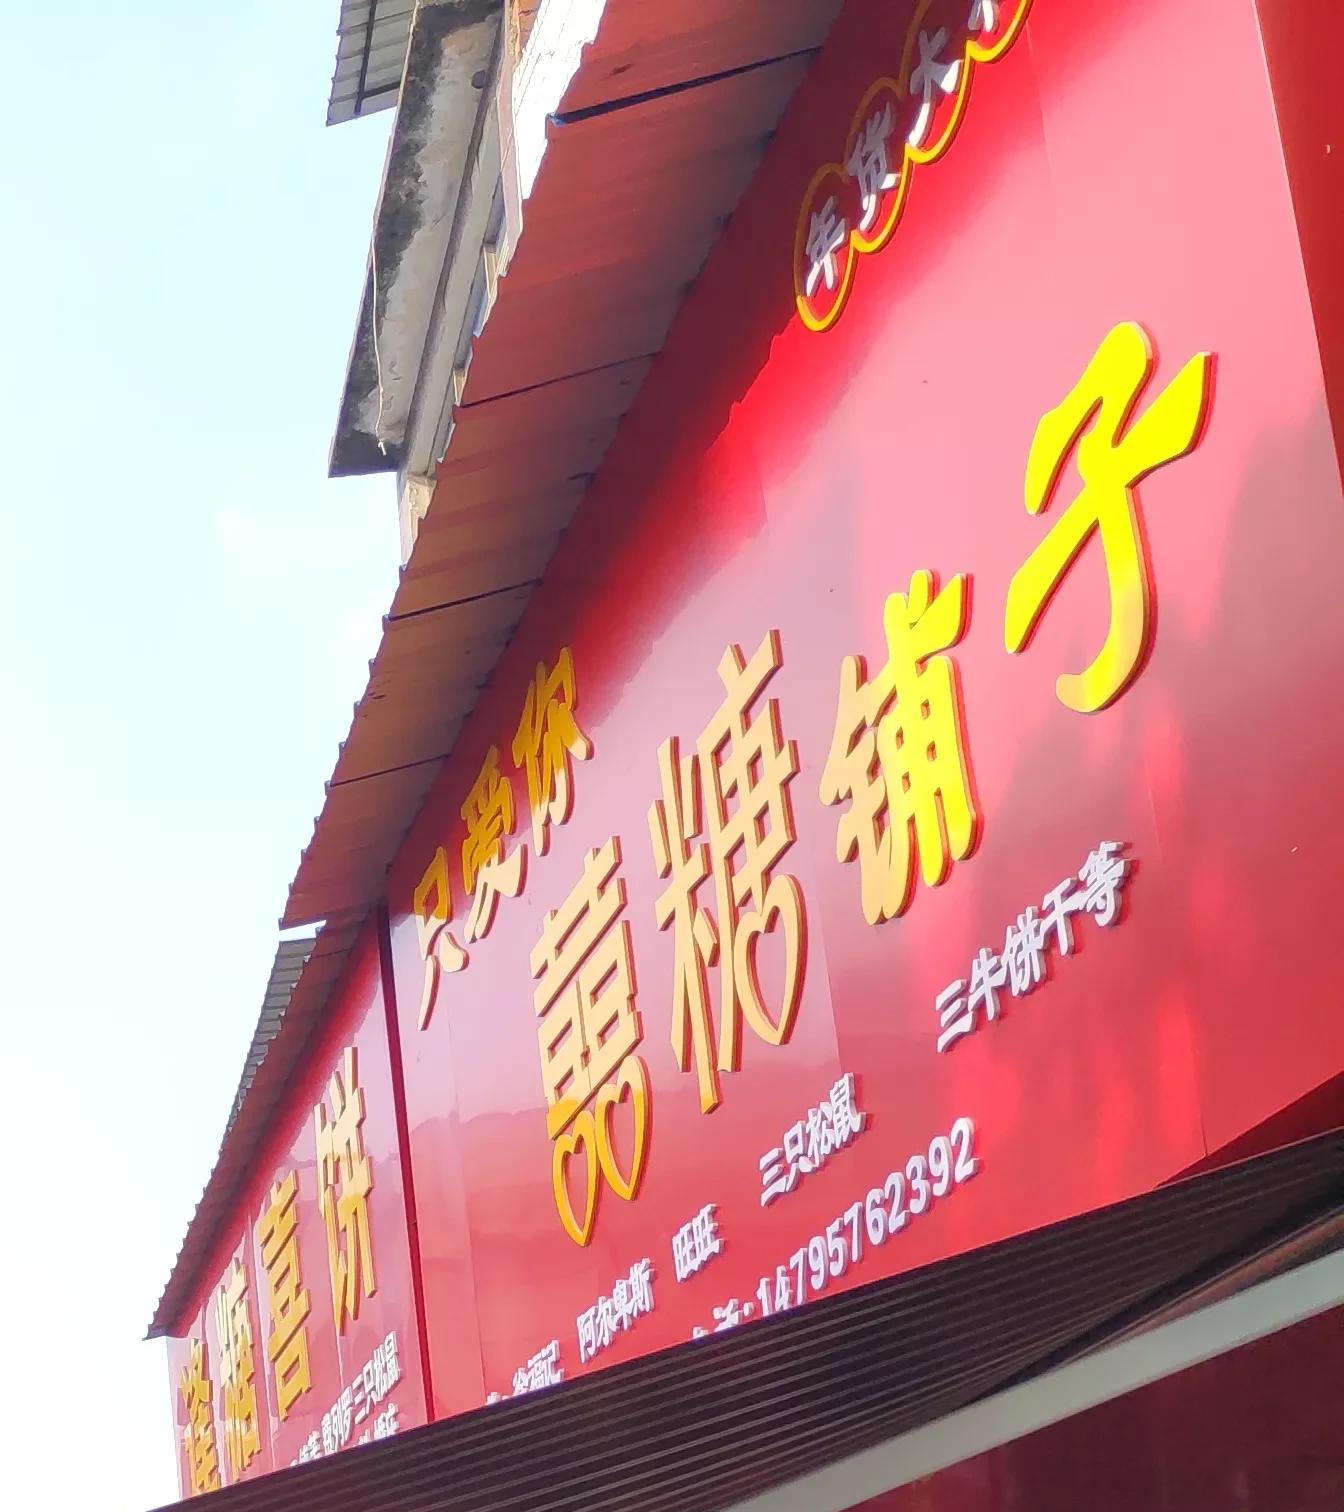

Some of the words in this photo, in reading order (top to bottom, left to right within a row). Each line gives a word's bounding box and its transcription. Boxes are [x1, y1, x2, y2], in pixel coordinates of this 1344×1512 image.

[410, 646, 595, 1030] 只爱你
[577, 1257, 656, 1363] 阿尔卑斯
[672, 1204, 723, 1283] 旺旺
[759, 1073, 864, 1207] 三只松鼠
[936, 841, 1133, 1051] 三牛饼干等
